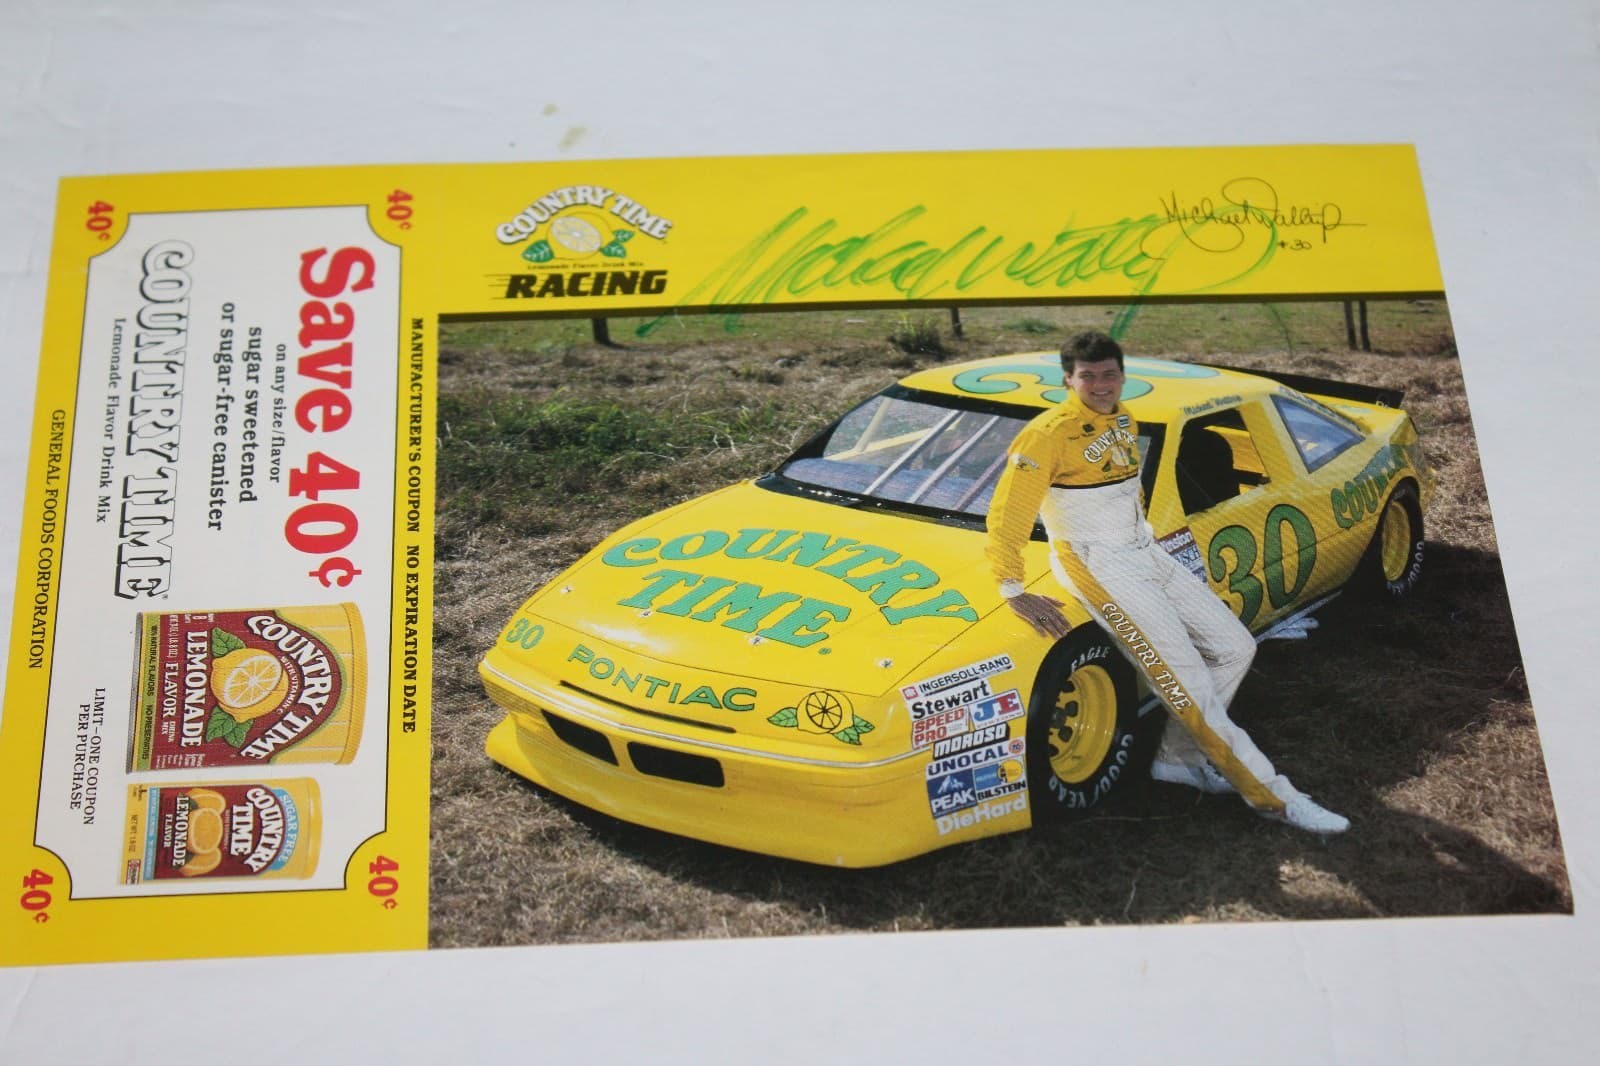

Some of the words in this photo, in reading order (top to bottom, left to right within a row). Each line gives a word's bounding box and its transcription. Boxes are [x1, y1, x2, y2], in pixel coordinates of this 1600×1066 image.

[495, 185, 616, 246] COUNTRY
[609, 194, 673, 240] TIME
[505, 269, 668, 299] RACING
[221, 302, 235, 323] or
[294, 246, 376, 434] Save
[109, 318, 126, 389] Lemonade
[126, 239, 195, 463] COUNTRY
[241, 326, 262, 384] sugar
[275, 343, 286, 362] on
[213, 329, 235, 436] sugar-free
[270, 366, 286, 393] any
[408, 318, 424, 463] MANUFACTURER'S
[104, 395, 120, 440] Flavor
[269, 397, 287, 484] size/flavor
[46, 409, 66, 485] GENERAL
[99, 446, 115, 488] Drink
[239, 389, 259, 503] sweetened
[96, 495, 111, 523] Mix
[208, 443, 229, 531] canister
[406, 463, 421, 533] COUPON
[40, 488, 59, 544] FOODS
[114, 466, 178, 600] TIME
[284, 451, 362, 588] 40¢
[406, 545, 420, 569] NO
[601, 528, 979, 626] COUNTRY
[1208, 503, 1317, 628] 30
[29, 547, 55, 669] CORPORATION
[404, 572, 419, 682] EXPIRATION
[505, 617, 545, 650] 30
[617, 568, 852, 649] TIME
[247, 615, 332, 715] COUNTRY
[567, 643, 757, 713] PONTIAC
[918, 656, 1011, 694] INGERSOLL-RAND
[1071, 645, 1110, 673] EAGLE
[1102, 602, 1164, 669] COUNTRY
[1156, 670, 1192, 711] TIME
[162, 662, 178, 718] FLAVOR
[181, 630, 208, 747] LEMONADE
[403, 684, 417, 733] DATE
[911, 680, 990, 719] Stewart
[973, 693, 1020, 722] JE
[77, 704, 90, 731] PER
[240, 711, 313, 760] TIME
[913, 726, 947, 746] PRO
[914, 707, 965, 734] SPEED
[934, 723, 1007, 758] MOROSO
[70, 734, 88, 810] PURCHASE
[927, 745, 1008, 776] UNOCAL
[83, 767, 99, 825] COUPON
[280, 794, 298, 832] SUGAR
[931, 788, 977, 814] PEAK
[936, 793, 1027, 836] DieHard
[977, 780, 1027, 801] BILSTEIN
[163, 813, 173, 848] FLAVOR
[172, 796, 189, 867] LEMONADE
[230, 802, 254, 856] TIME
[243, 787, 284, 872] COUNTRY
[278, 832, 298, 862] FREE
